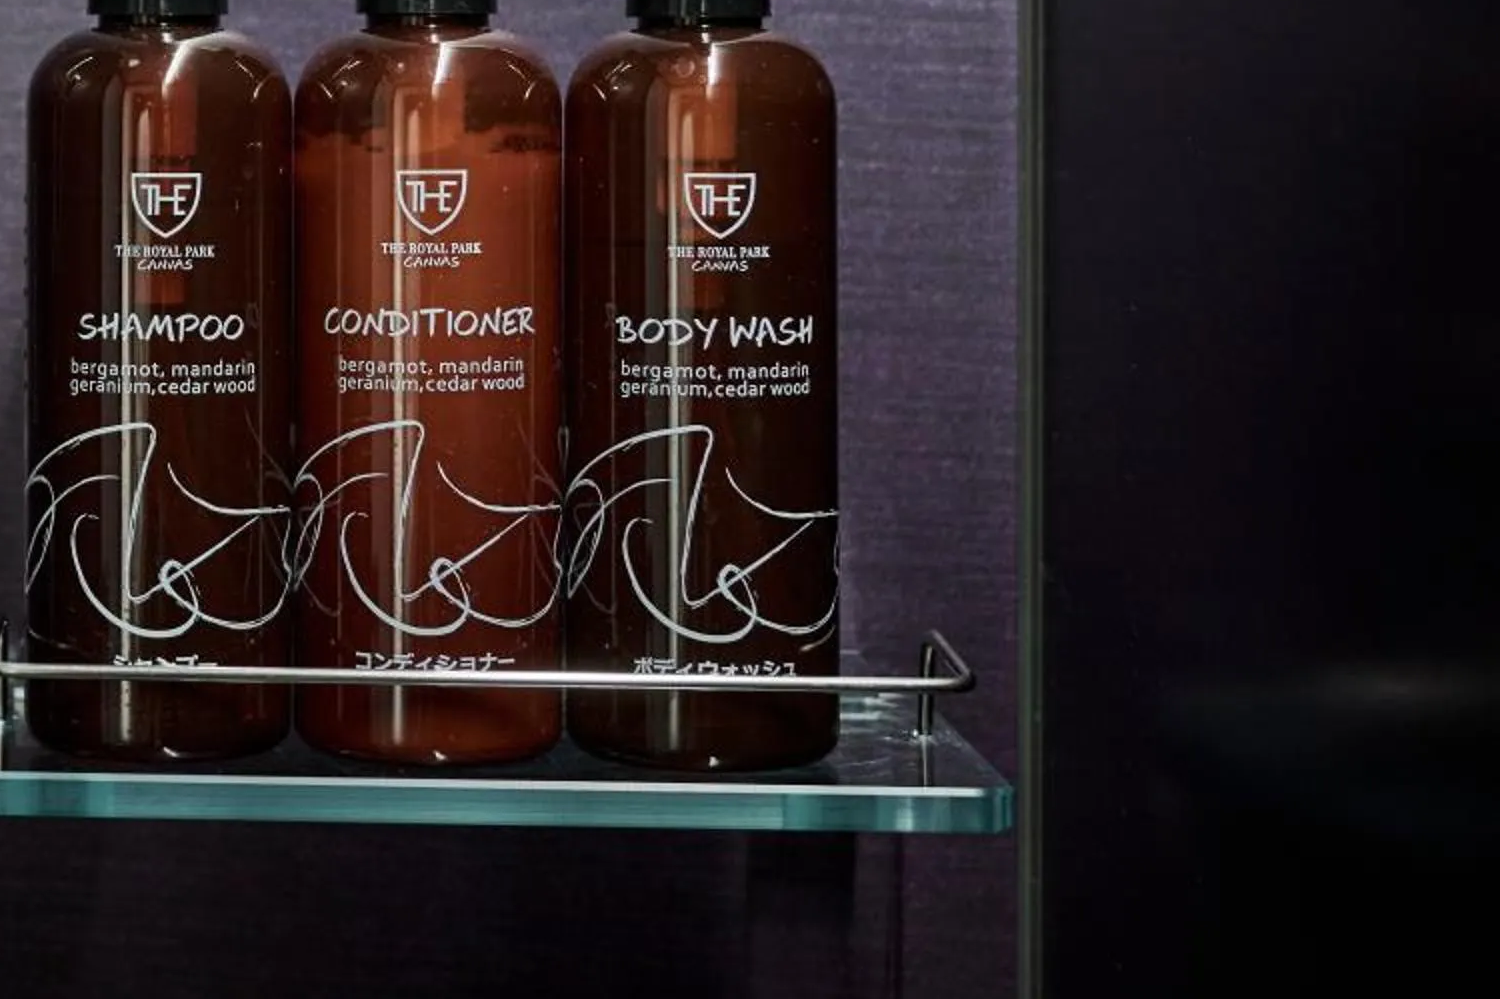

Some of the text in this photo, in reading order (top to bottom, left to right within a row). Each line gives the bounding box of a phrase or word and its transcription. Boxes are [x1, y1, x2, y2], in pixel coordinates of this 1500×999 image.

[140, 184, 192, 216] THE
[405, 180, 457, 213] THE
[694, 184, 746, 216] THE
[114, 244, 215, 257] THE ROYAL PARK
[380, 242, 482, 254] THE ROYAL PARK
[668, 246, 770, 258] THE ROYAL PARK
[137, 259, 194, 271] CANVAS
[403, 256, 461, 268] CANVAS
[691, 260, 749, 272] CANVAS
[77, 312, 244, 343] SHAMPOO
[324, 306, 536, 337] CONDITIONER
[615, 314, 813, 350] BODY WASH
[70, 357, 256, 380] bergamot, mandarin
[338, 355, 524, 377] bergamot, mandarin
[621, 359, 809, 381] bergamot, mandarin
[213, 376, 256, 394] wood
[481, 373, 525, 390] wood
[770, 377, 811, 396] wood
[355, 651, 515, 672] コンディショナー
